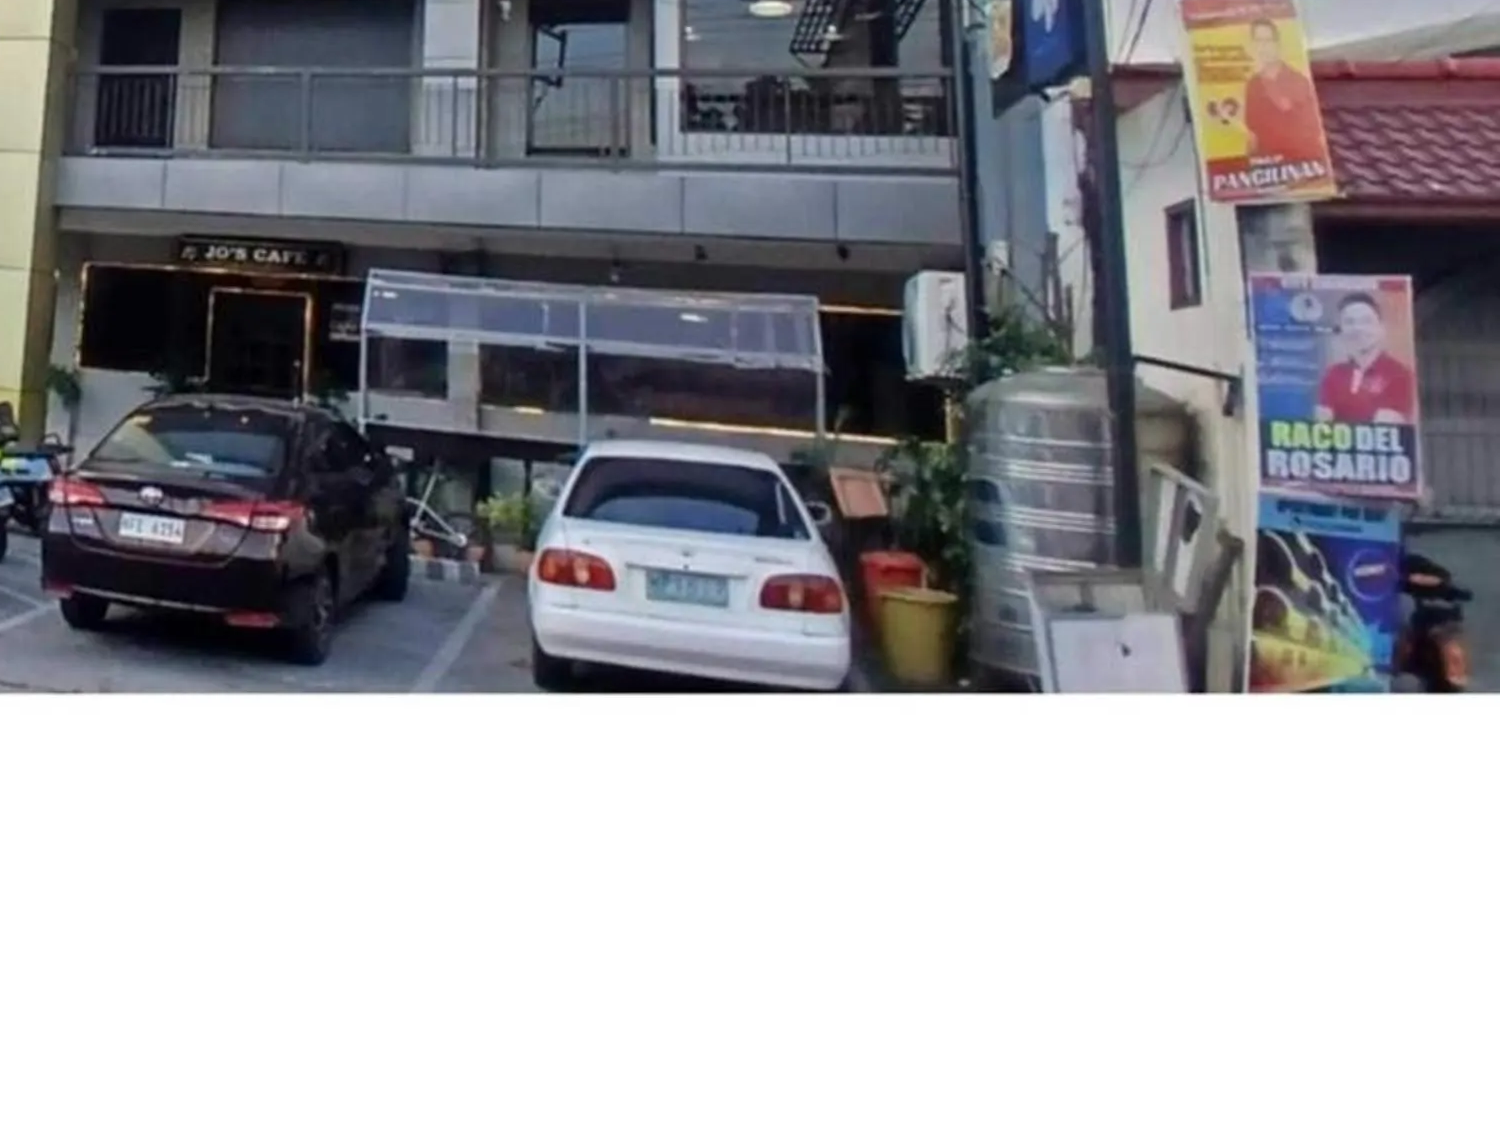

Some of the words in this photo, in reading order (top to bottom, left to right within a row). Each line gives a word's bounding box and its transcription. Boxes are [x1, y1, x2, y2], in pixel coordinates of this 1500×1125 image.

[205, 245, 247, 262] JO'S
[1270, 420, 1351, 450] RACO
[1355, 425, 1404, 452] DEL
[1267, 448, 1411, 483] ROSARIO
